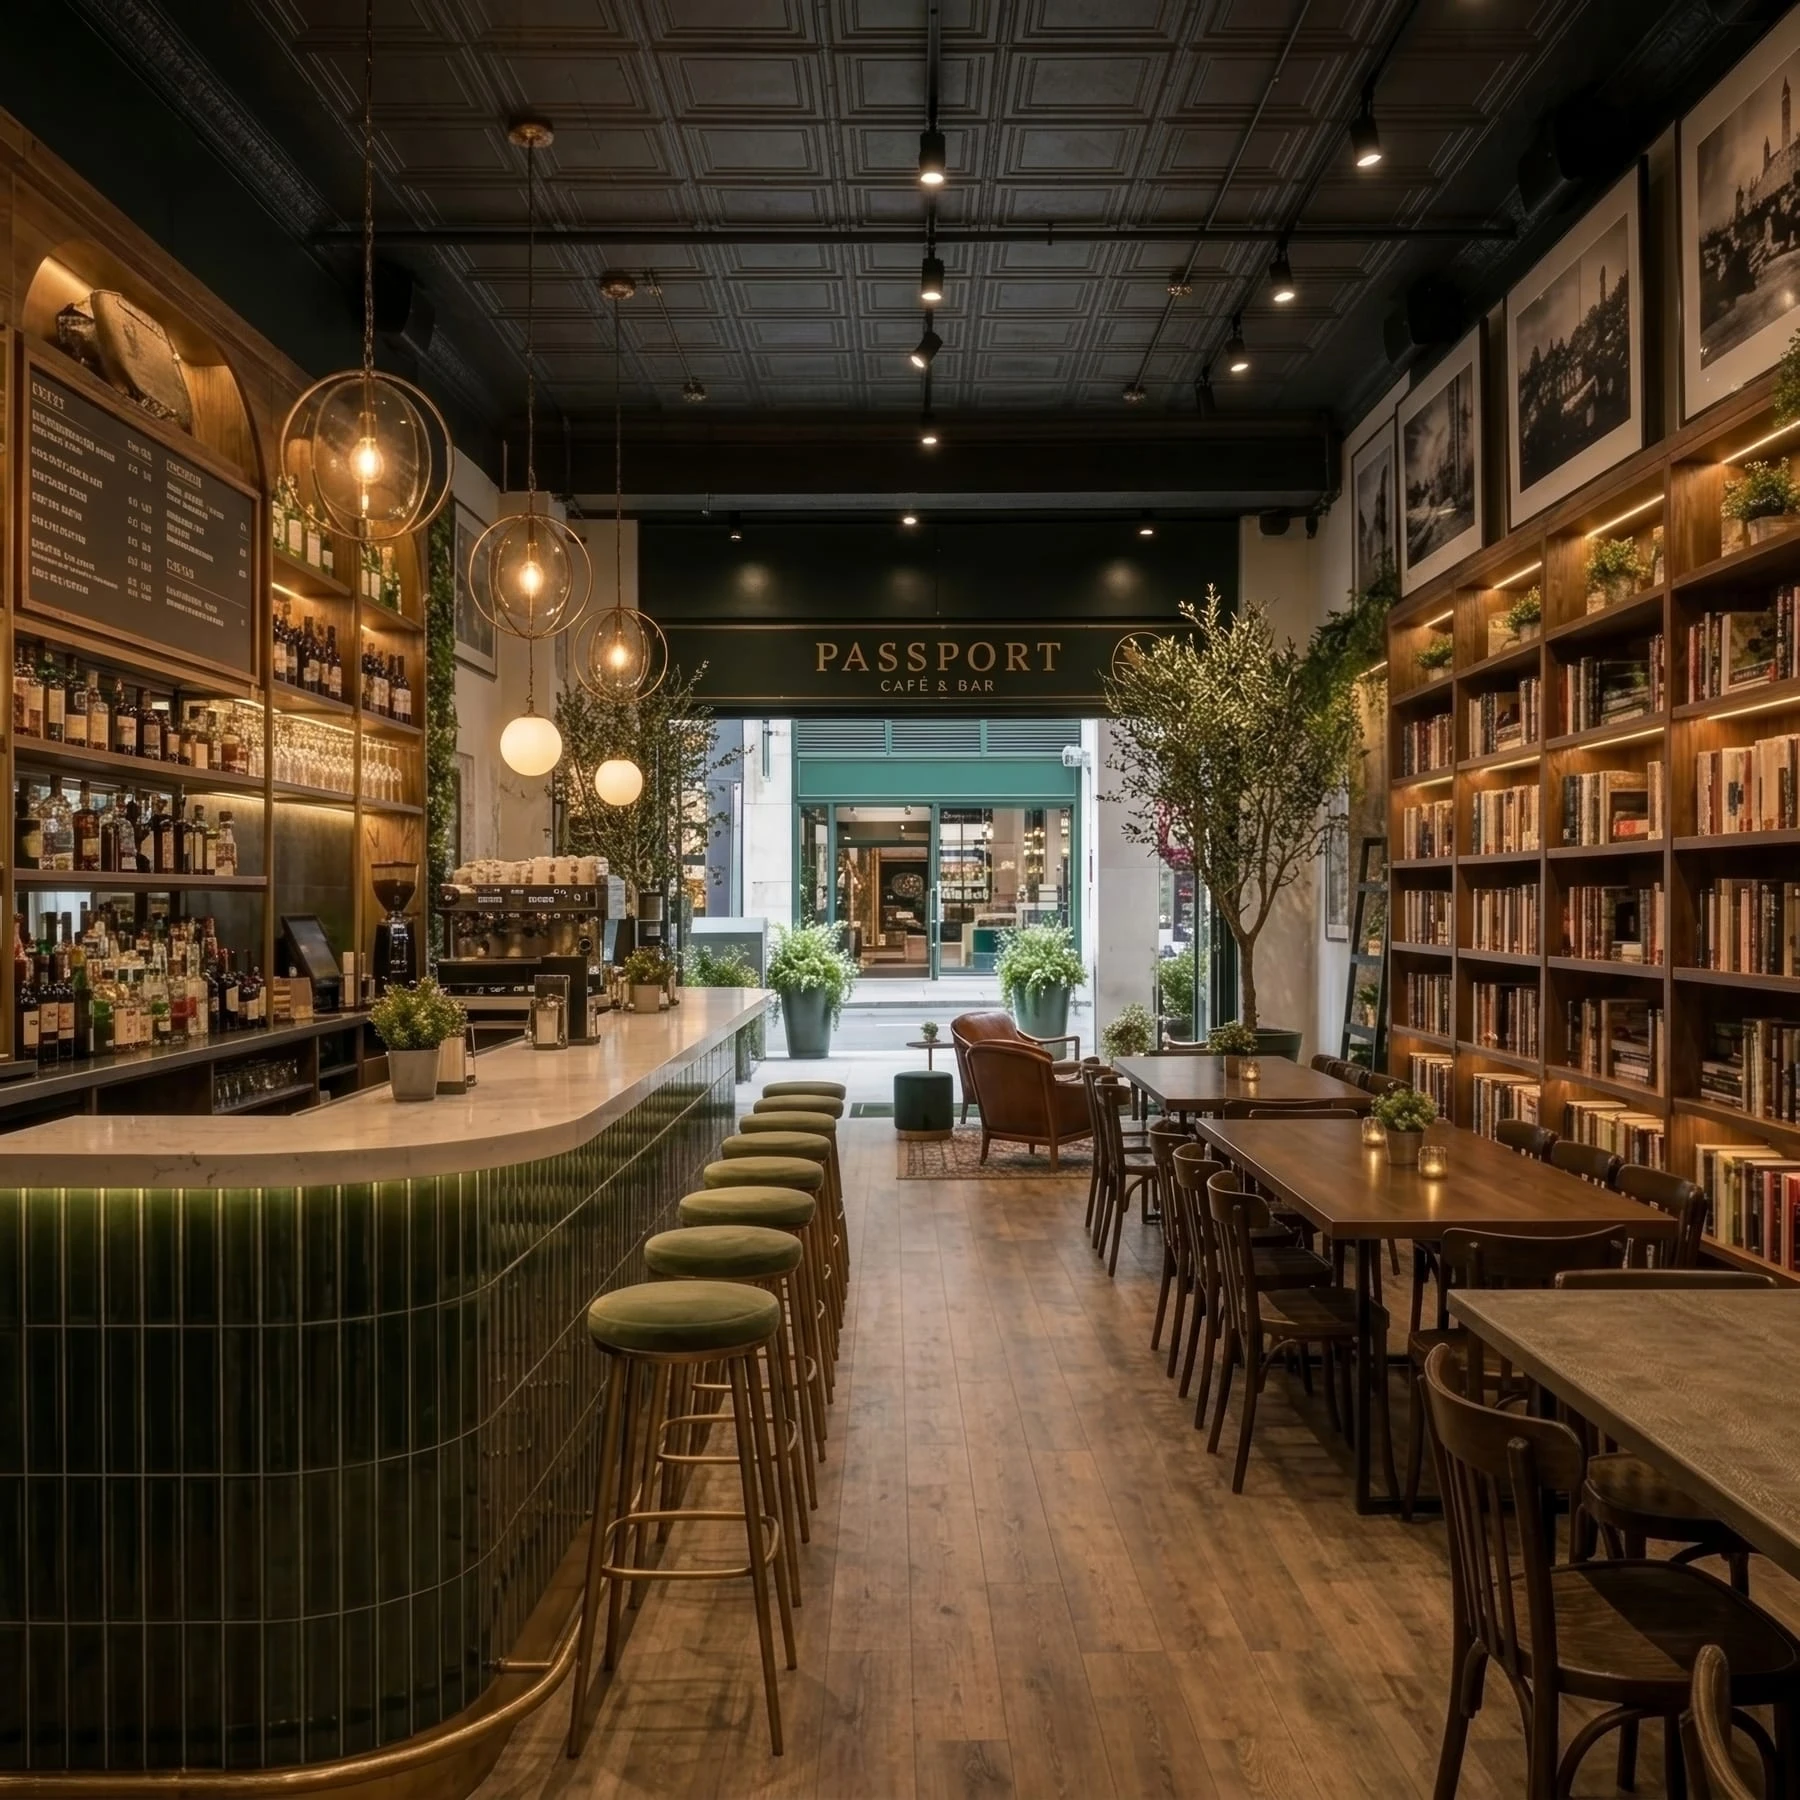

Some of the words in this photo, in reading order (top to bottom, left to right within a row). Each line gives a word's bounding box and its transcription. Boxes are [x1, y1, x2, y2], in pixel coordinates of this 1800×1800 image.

[815, 642, 1061, 672] PASSPORT
[880, 676, 928, 692] CAFÉ
[937, 680, 948, 692] &
[958, 680, 994, 692] BAR
